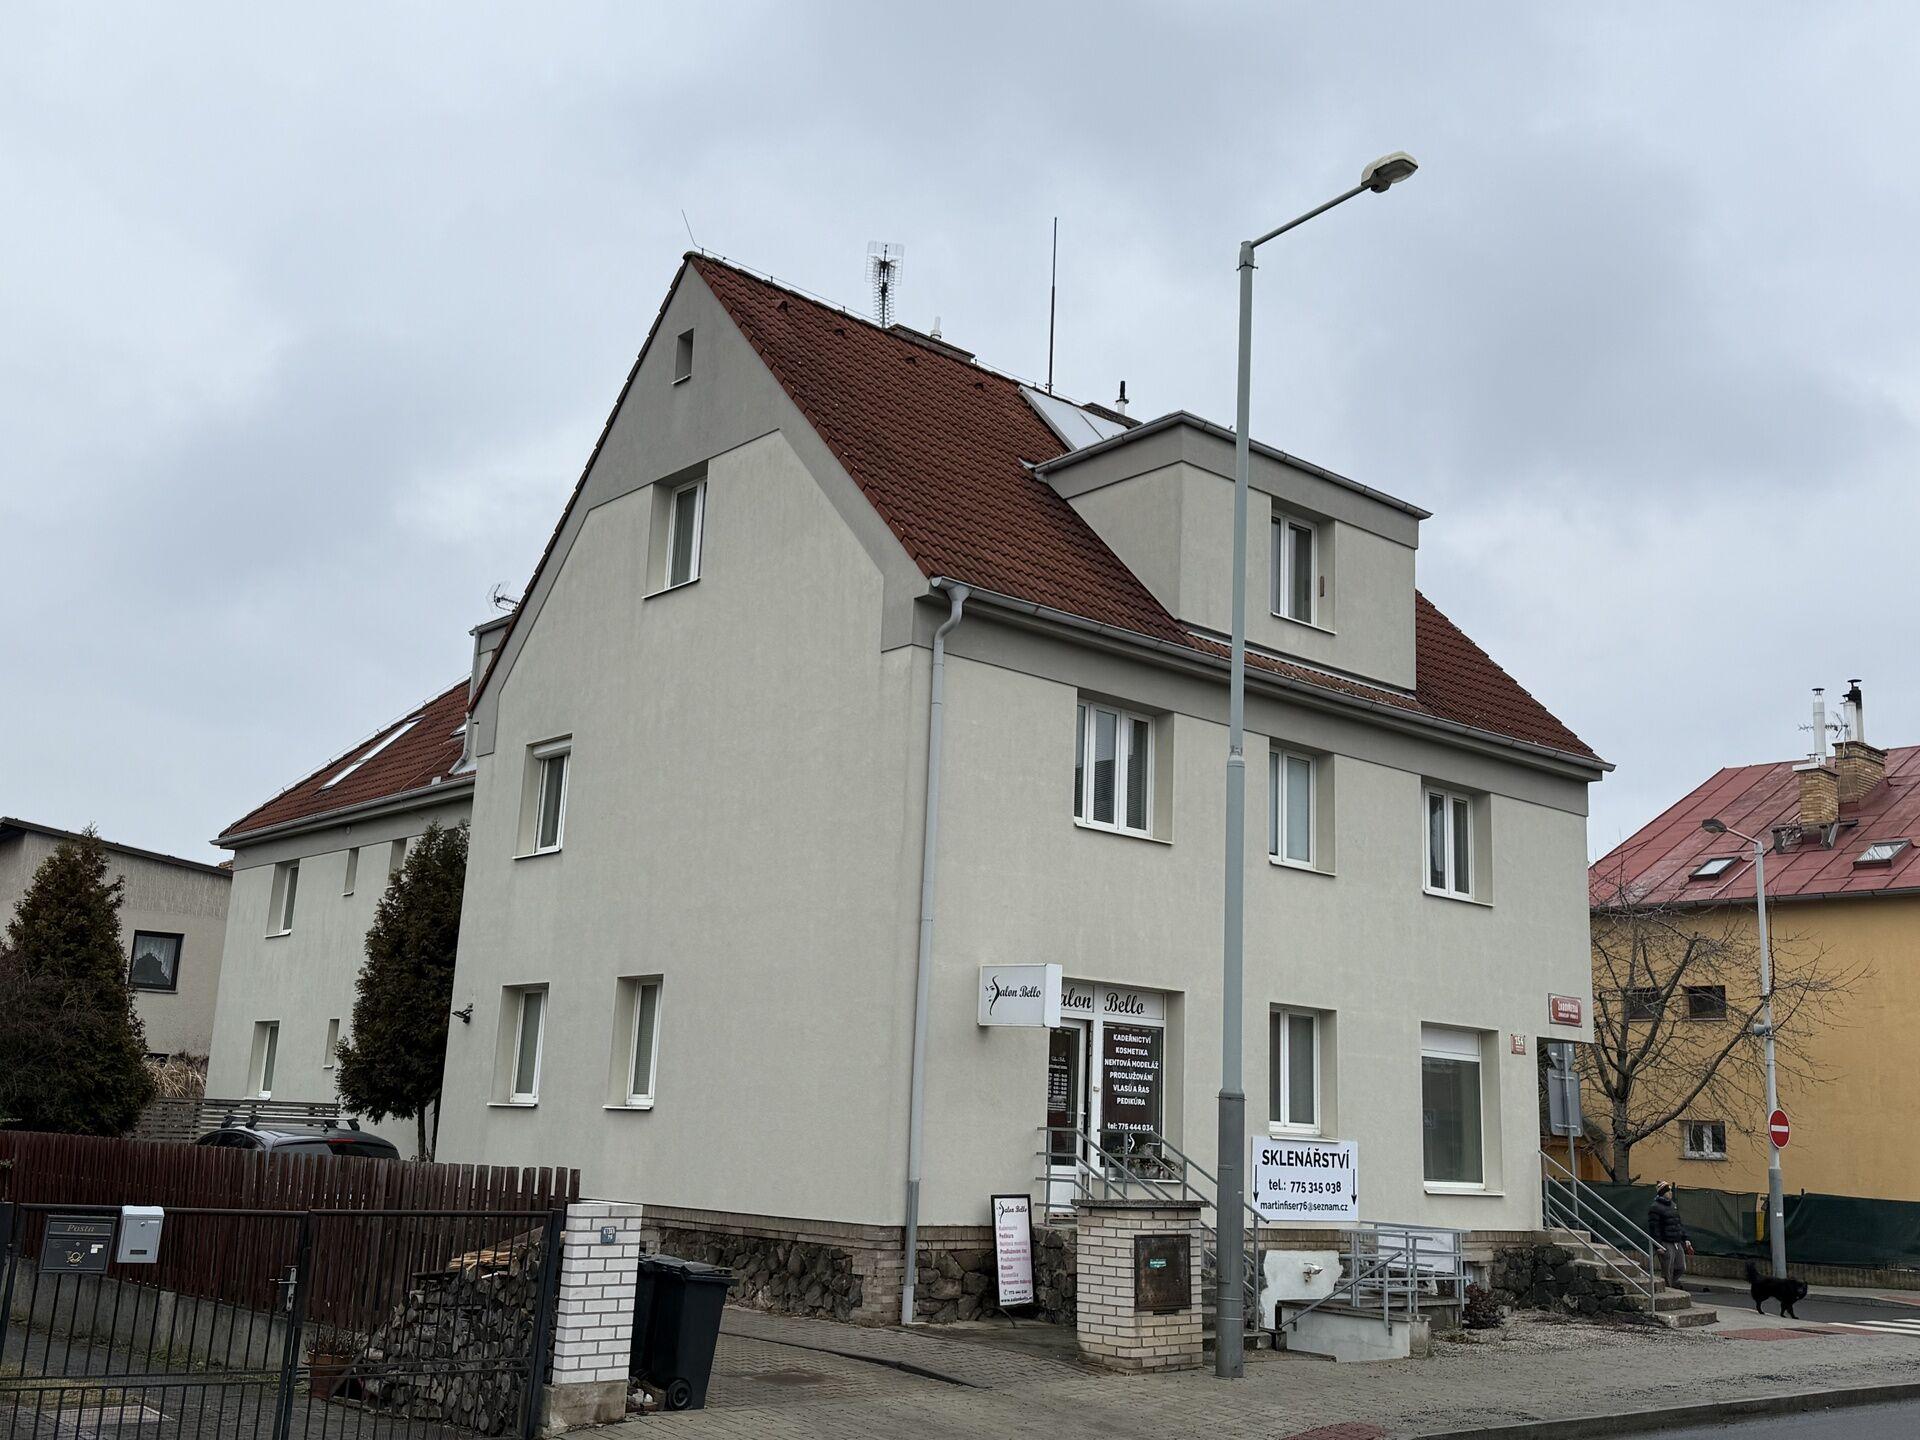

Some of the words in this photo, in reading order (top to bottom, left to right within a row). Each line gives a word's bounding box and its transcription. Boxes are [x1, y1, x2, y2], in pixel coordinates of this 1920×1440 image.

[1019, 985, 1041, 998] Bello
[1060, 987, 1092, 1009] alon
[1104, 992, 1145, 1015] Bello
[1113, 1033, 1152, 1044] KADEŘNICTVÍ
[1115, 1046, 1148, 1056] KOSMETIKA
[1104, 1058, 1131, 1067] NEHTOVÁ
[1131, 1060, 1159, 1069] MODELÁŽ
[1133, 1085, 1138, 1093] A
[1118, 1122, 1129, 1130] 775
[1129, 1123, 1142, 1131] 444
[1261, 1147, 1350, 1169] SKLENÁŘSTVÍ
[1268, 1178, 1287, 1191] tel.:
[1290, 1181, 1307, 1194] 775
[1308, 1181, 1323, 1194] 315
[1325, 1181, 1342, 1194] 038
[1260, 1200, 1349, 1212] martinfiser76@seznam.cz
